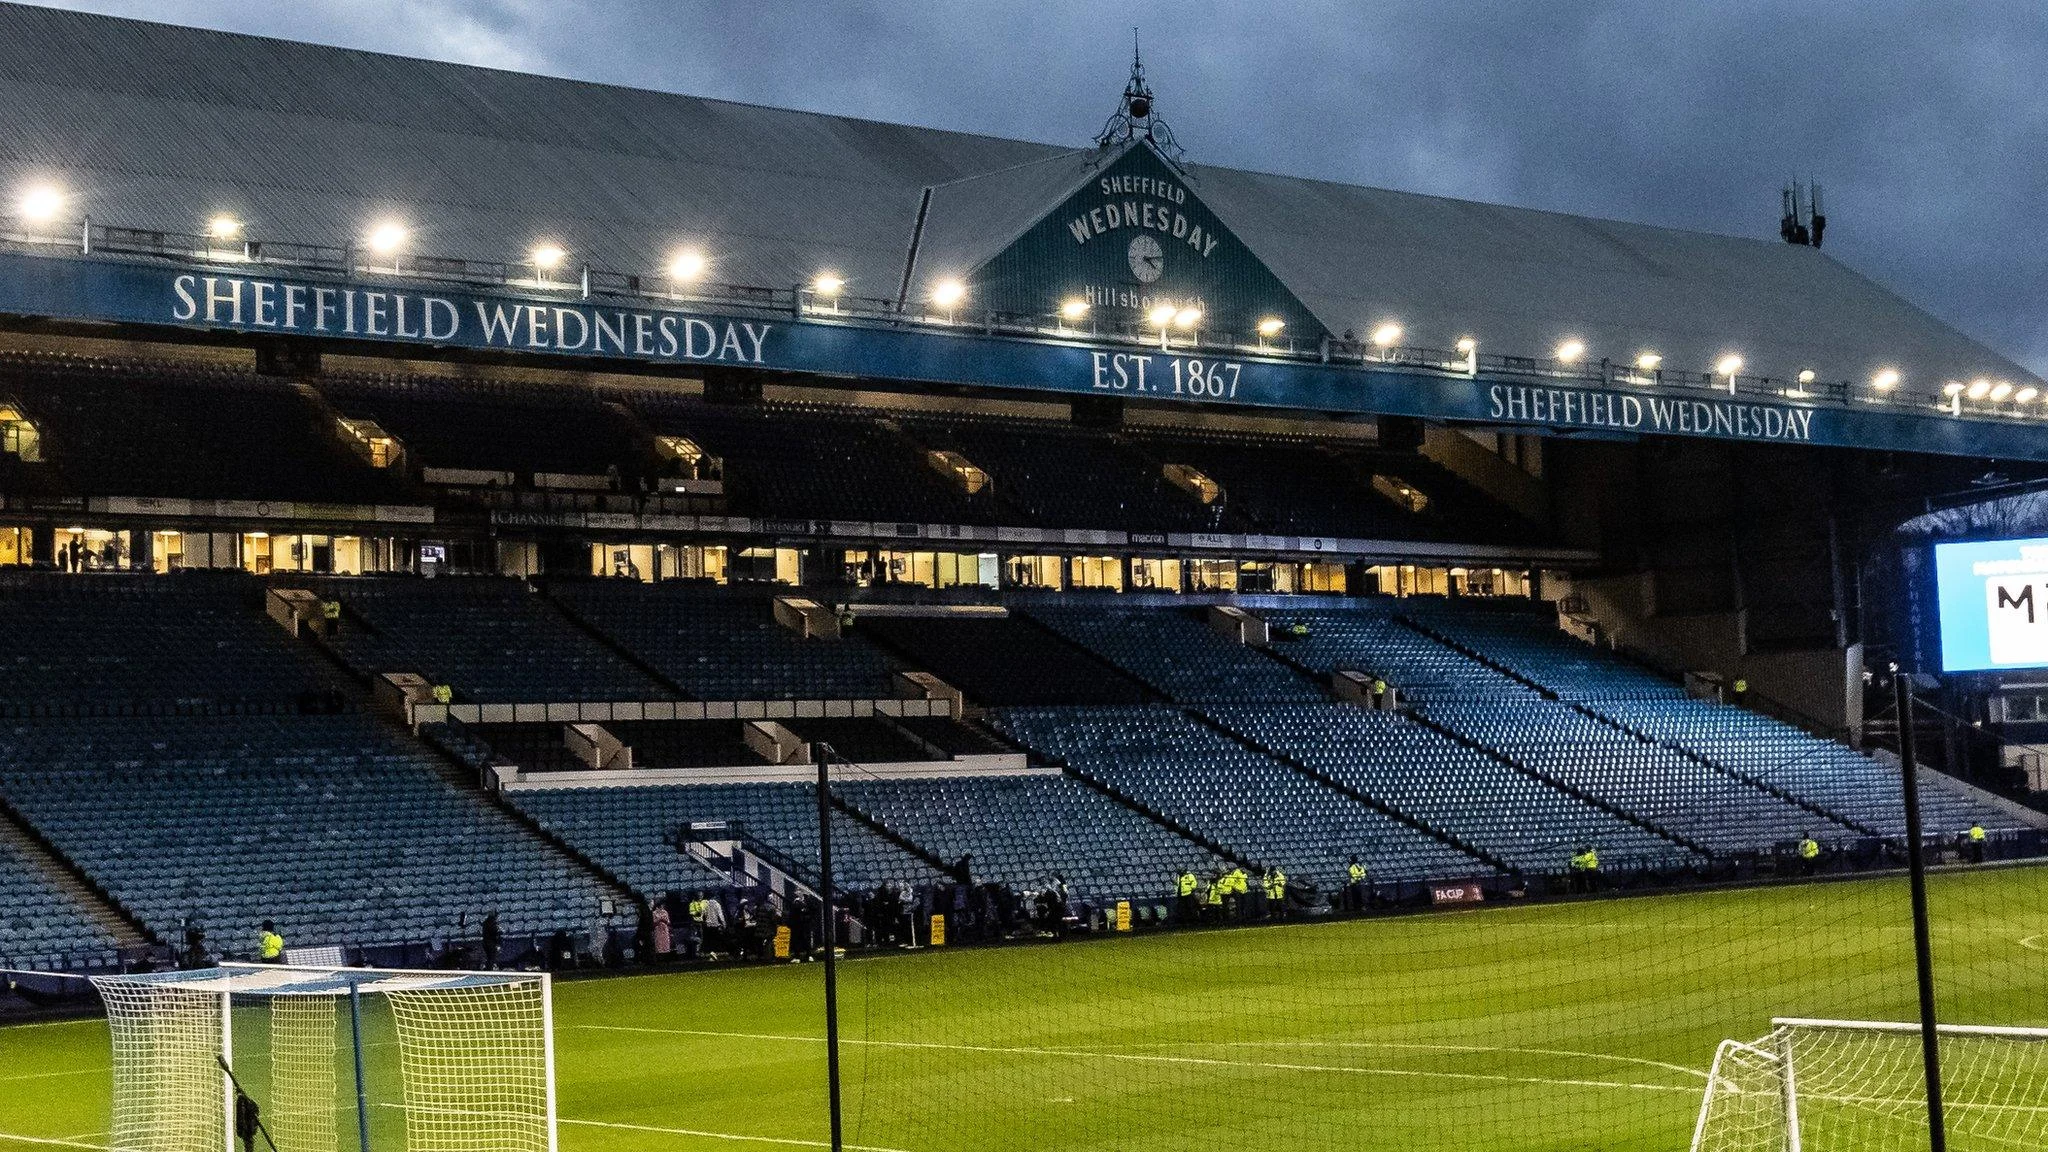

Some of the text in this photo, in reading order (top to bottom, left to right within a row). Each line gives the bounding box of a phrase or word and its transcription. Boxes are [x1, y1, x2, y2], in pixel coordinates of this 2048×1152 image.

[1101, 175, 1186, 205] SHEFFIELD
[1067, 201, 1218, 258] WEDNESDAY
[173, 275, 772, 363] SHEFFIELD WEDNESDAY
[1085, 285, 1205, 314] Hillsboh
[1090, 352, 1241, 398] EST. 1867
[1490, 385, 1813, 440] SHEFFIELD WEDNESDAY
[1997, 585, 2048, 624] M
[1435, 889, 1447, 901] FA
[1447, 888, 1464, 900] CUP
